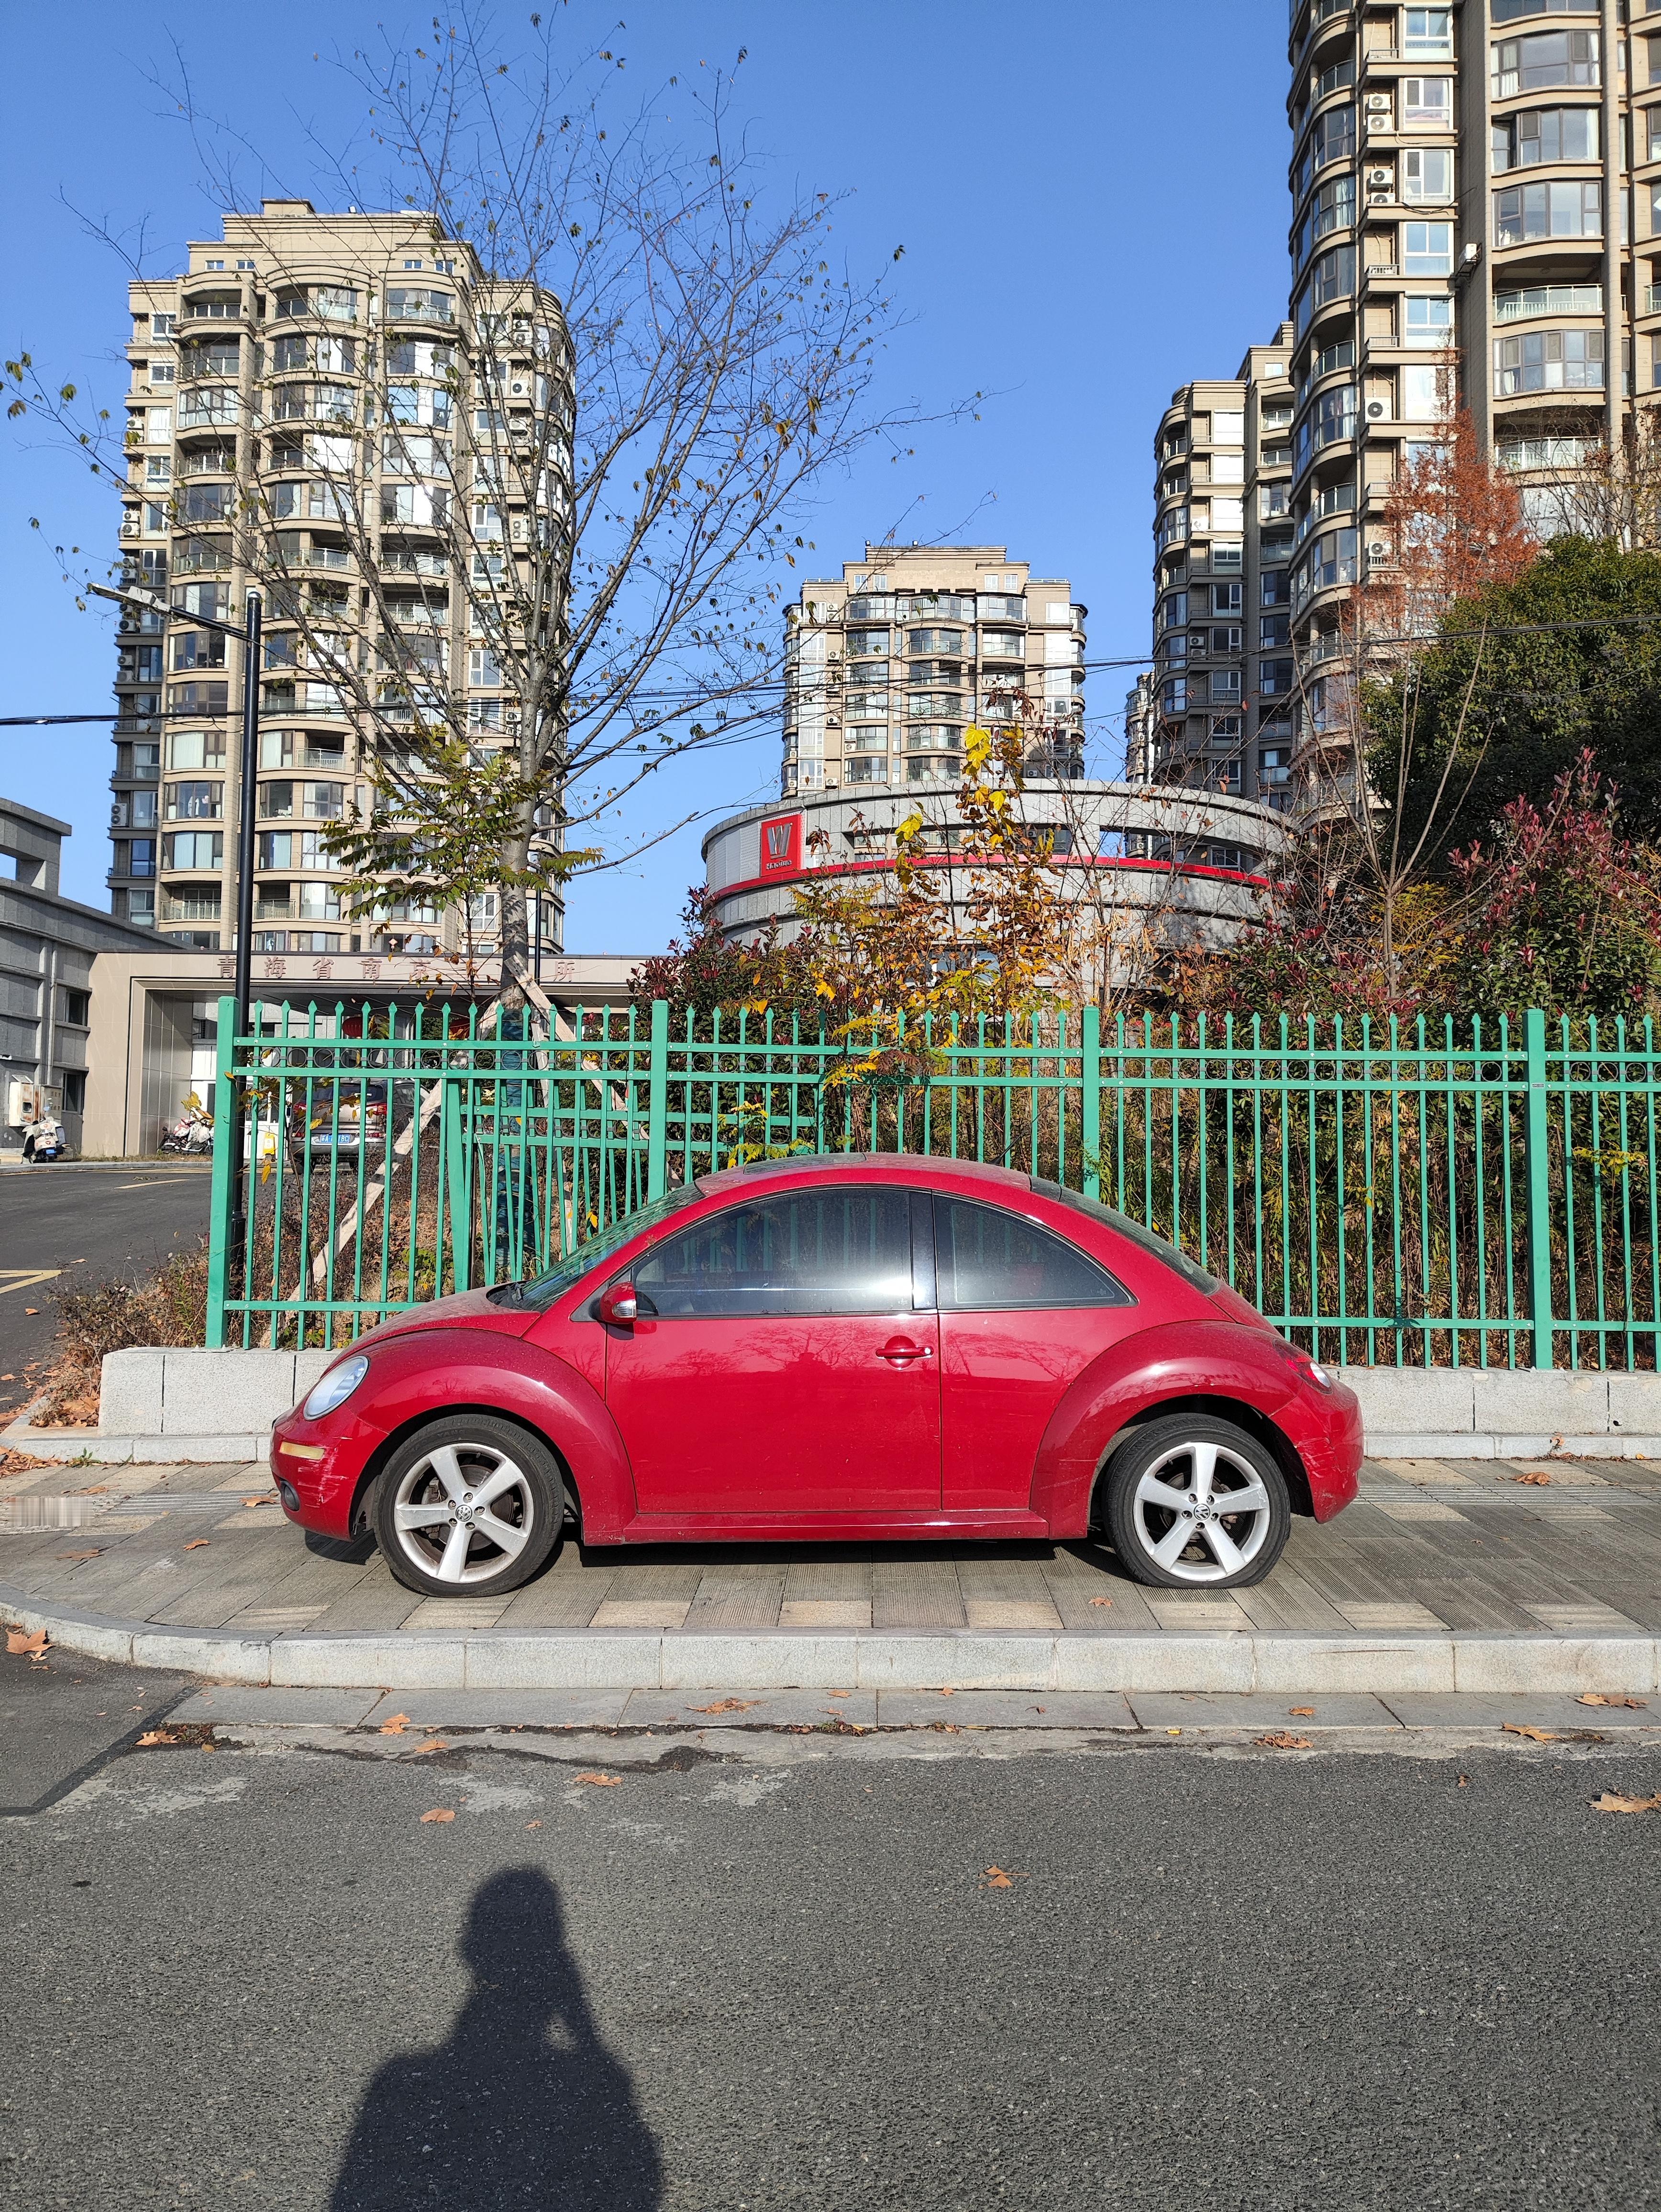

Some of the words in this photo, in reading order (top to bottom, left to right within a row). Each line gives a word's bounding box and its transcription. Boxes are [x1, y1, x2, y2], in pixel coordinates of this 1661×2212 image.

[217, 955, 575, 982] 青海省南京所
